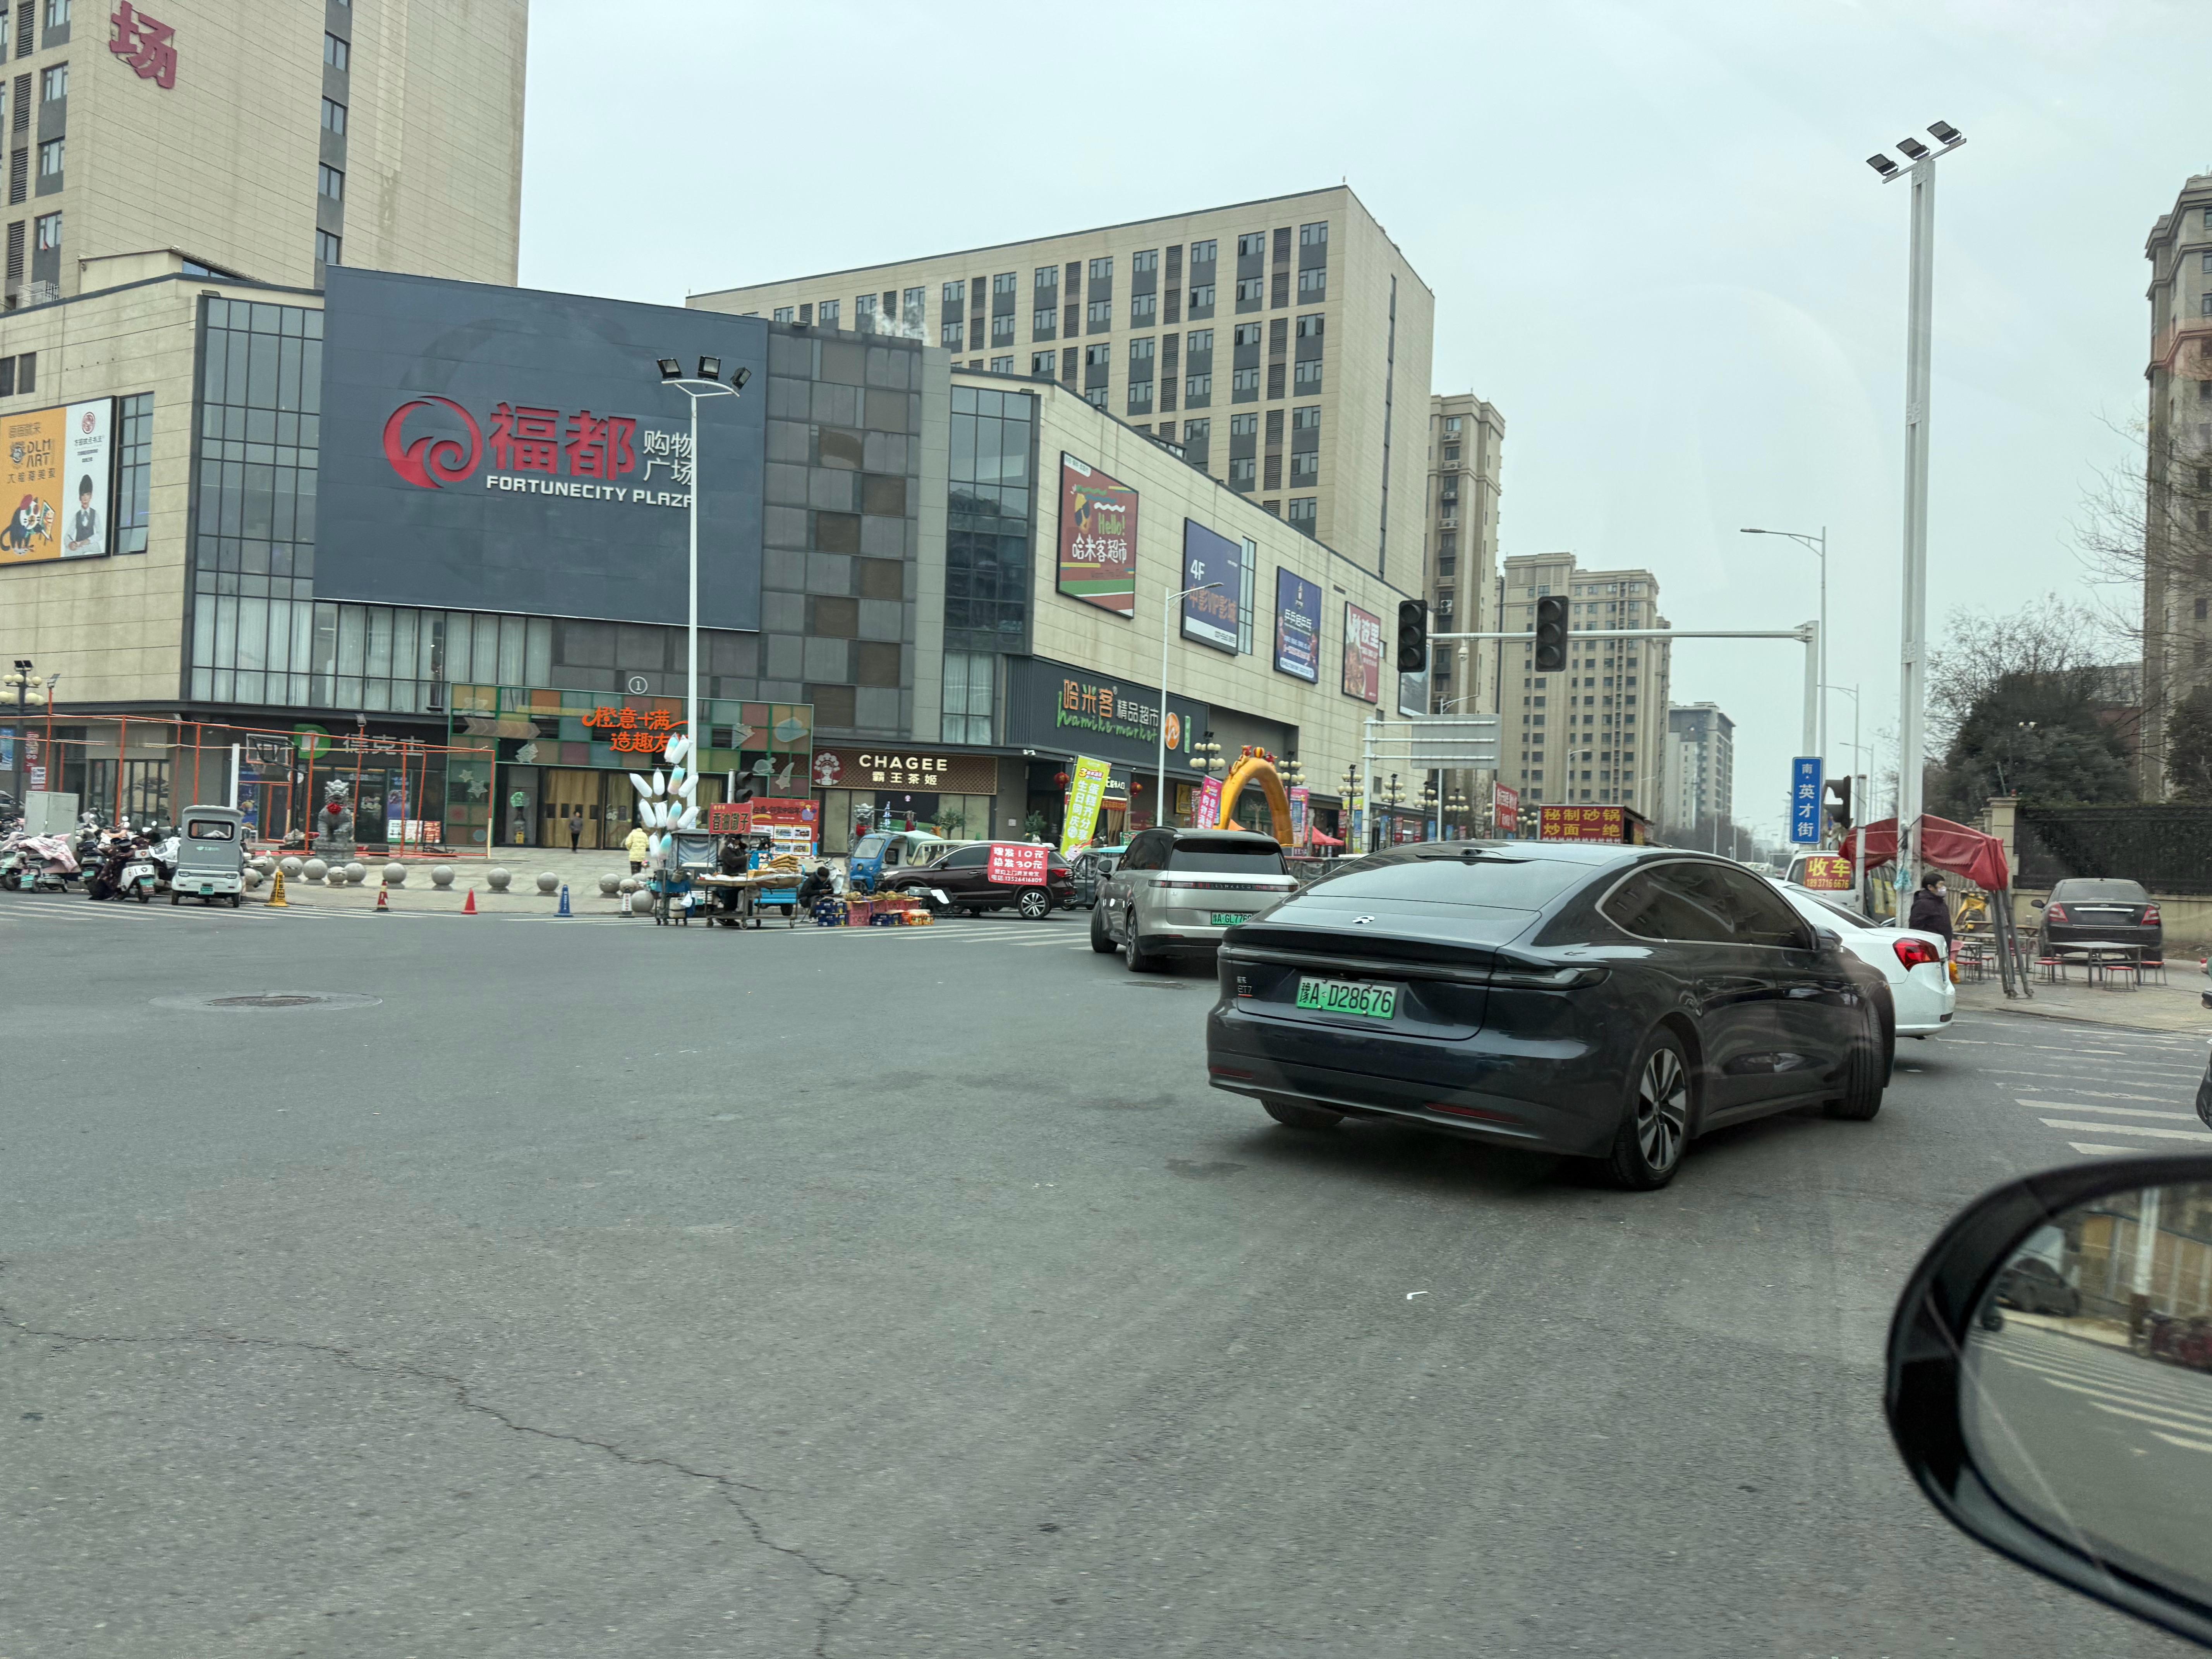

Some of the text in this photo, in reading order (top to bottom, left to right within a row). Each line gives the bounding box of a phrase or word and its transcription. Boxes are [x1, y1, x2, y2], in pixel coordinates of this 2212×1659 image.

[110, 0, 177, 89] 场
[489, 401, 636, 481] 福都
[643, 430, 692, 458] 购物
[643, 457, 692, 485] 广场
[486, 475, 628, 502] FORTUNECITY
[1098, 512, 1125, 536] Hello!
[1072, 533, 1127, 564] 哈米客超市
[1190, 559, 1205, 580] 4F
[1063, 679, 1113, 718] 哈米客
[1117, 699, 1159, 727] 精品超市
[609, 731, 688, 752] 造趣友
[859, 754, 948, 771] CHAGEE
[872, 771, 938, 785] 霸王茶姬
[1544, 808, 1621, 822] 秘制砂锅
[1543, 823, 1621, 837] 炒面一绝
[1808, 857, 1851, 878] 收车
